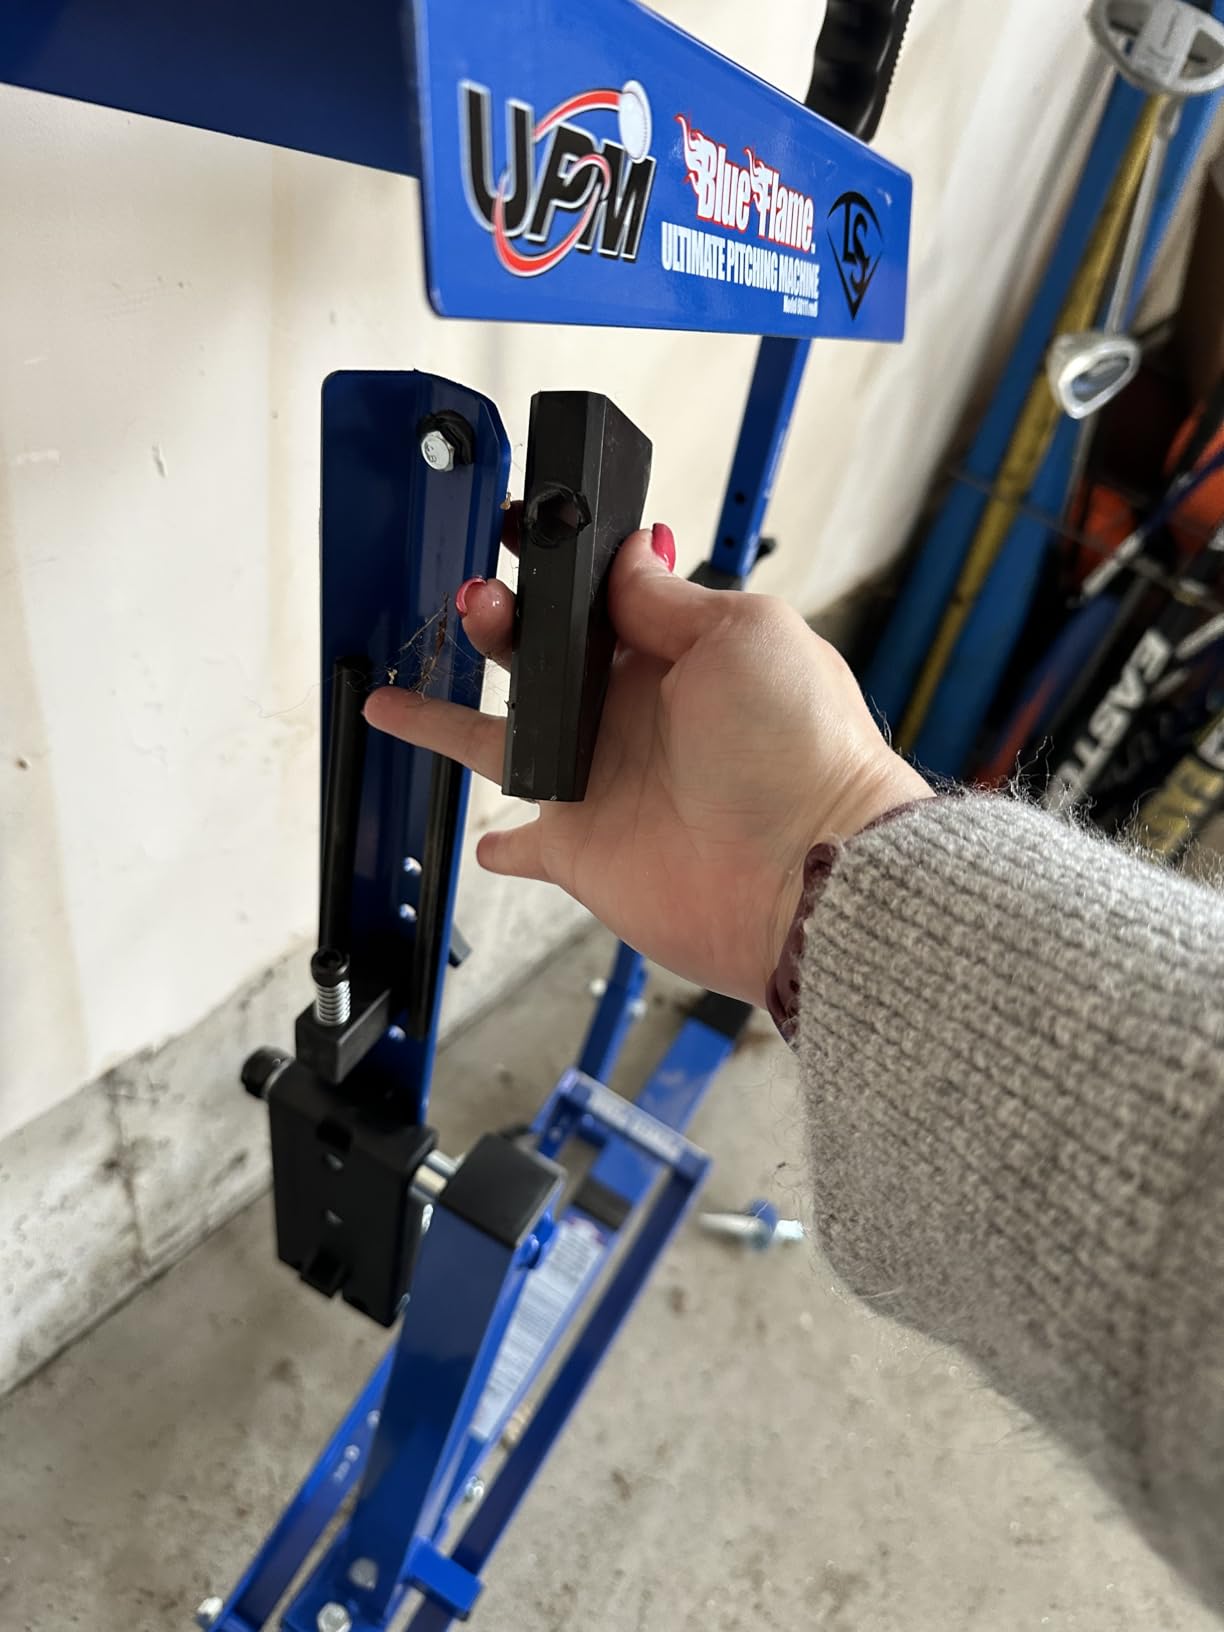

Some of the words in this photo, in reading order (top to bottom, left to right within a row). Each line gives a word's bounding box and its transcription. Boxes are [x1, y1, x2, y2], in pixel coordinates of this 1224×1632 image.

[458, 79, 656, 263] UPM
[676, 116, 750, 233] Blue
[661, 221, 725, 281] ULTIMATE
[726, 240, 778, 291] PITCHING
[778, 254, 820, 299] MACHINE
[1043, 628, 1170, 808] EASTO
